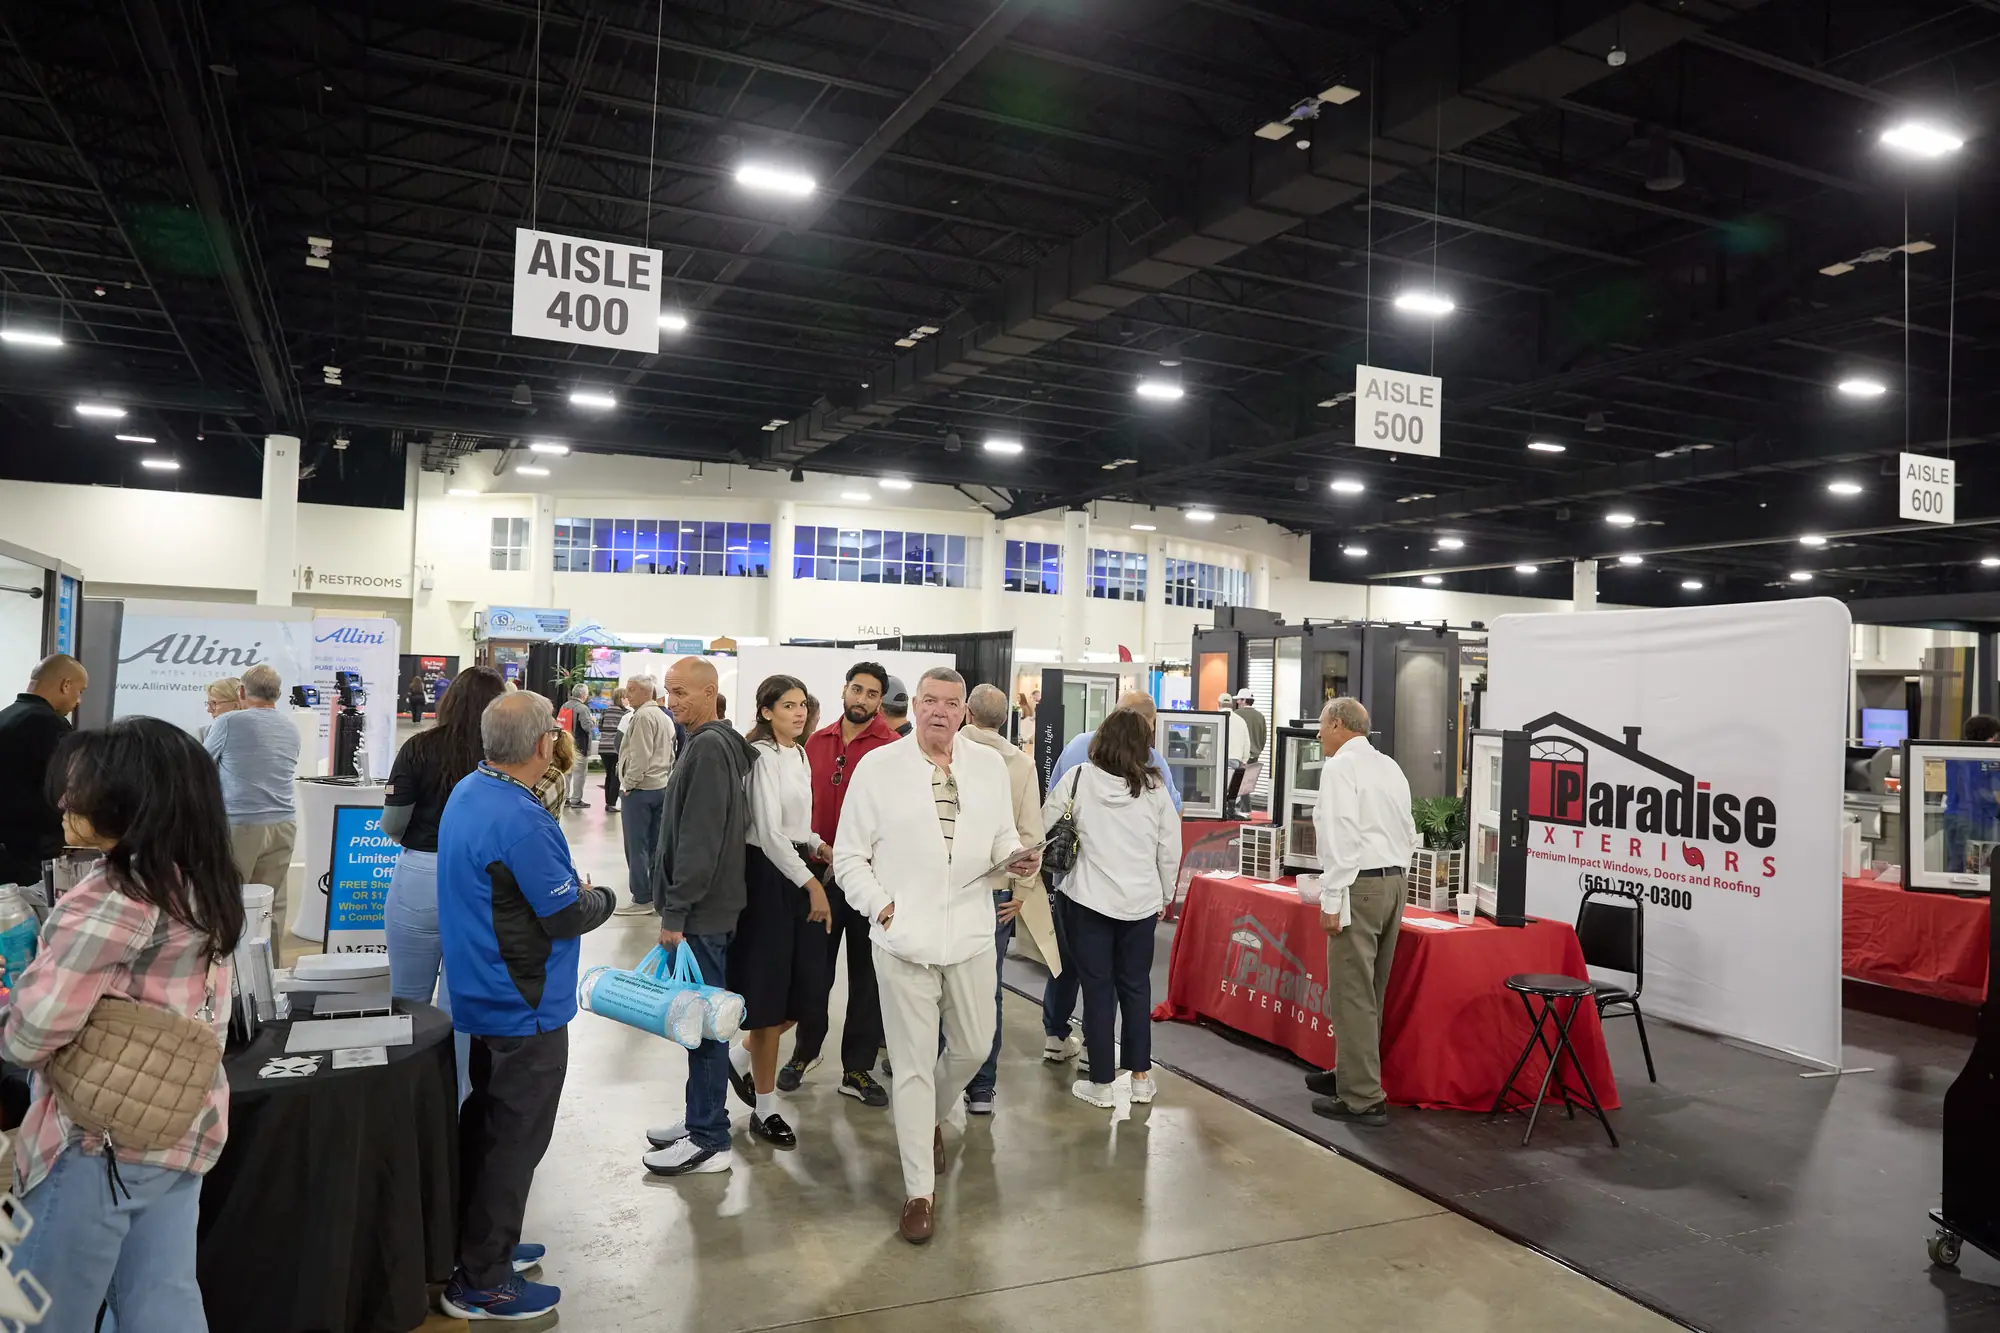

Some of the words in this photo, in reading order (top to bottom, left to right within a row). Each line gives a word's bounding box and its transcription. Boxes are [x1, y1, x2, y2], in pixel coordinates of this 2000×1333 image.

[527, 238, 651, 292] AISLE
[546, 291, 629, 336] 400
[1365, 378, 1434, 408] AISLE
[1373, 410, 1424, 445] 500
[1906, 463, 1949, 485] AISLE
[1911, 488, 1943, 514] 600
[318, 574, 403, 588] RESTROOMS
[315, 627, 385, 644] Allini
[858, 625, 889, 636] HALL
[893, 626, 901, 636] B
[117, 632, 262, 667] Allini
[116, 682, 206, 692] ww.AlliniWater
[1045, 723, 1053, 744] light.
[1046, 745, 1051, 754] to
[1557, 770, 1777, 848] Paradise
[348, 853, 399, 864] Limited
[373, 867, 394, 878] Off
[1526, 848, 1566, 863] Premium
[1568, 854, 1601, 868] Impact
[1602, 859, 1651, 877] Windows,
[1654, 867, 1686, 882] Doors
[1688, 875, 1710, 887] and
[1713, 876, 1761, 898] Roofing
[339, 880, 368, 889] FREE
[371, 880, 391, 889] Sho
[352, 891, 369, 900] OR
[371, 891, 386, 901] $1,
[339, 902, 367, 911] When
[370, 902, 385, 911] Yo
[339, 914, 346, 922] a
[333, 944, 388, 954] AMER
[1220, 979, 1336, 1038] EXTERIORS
